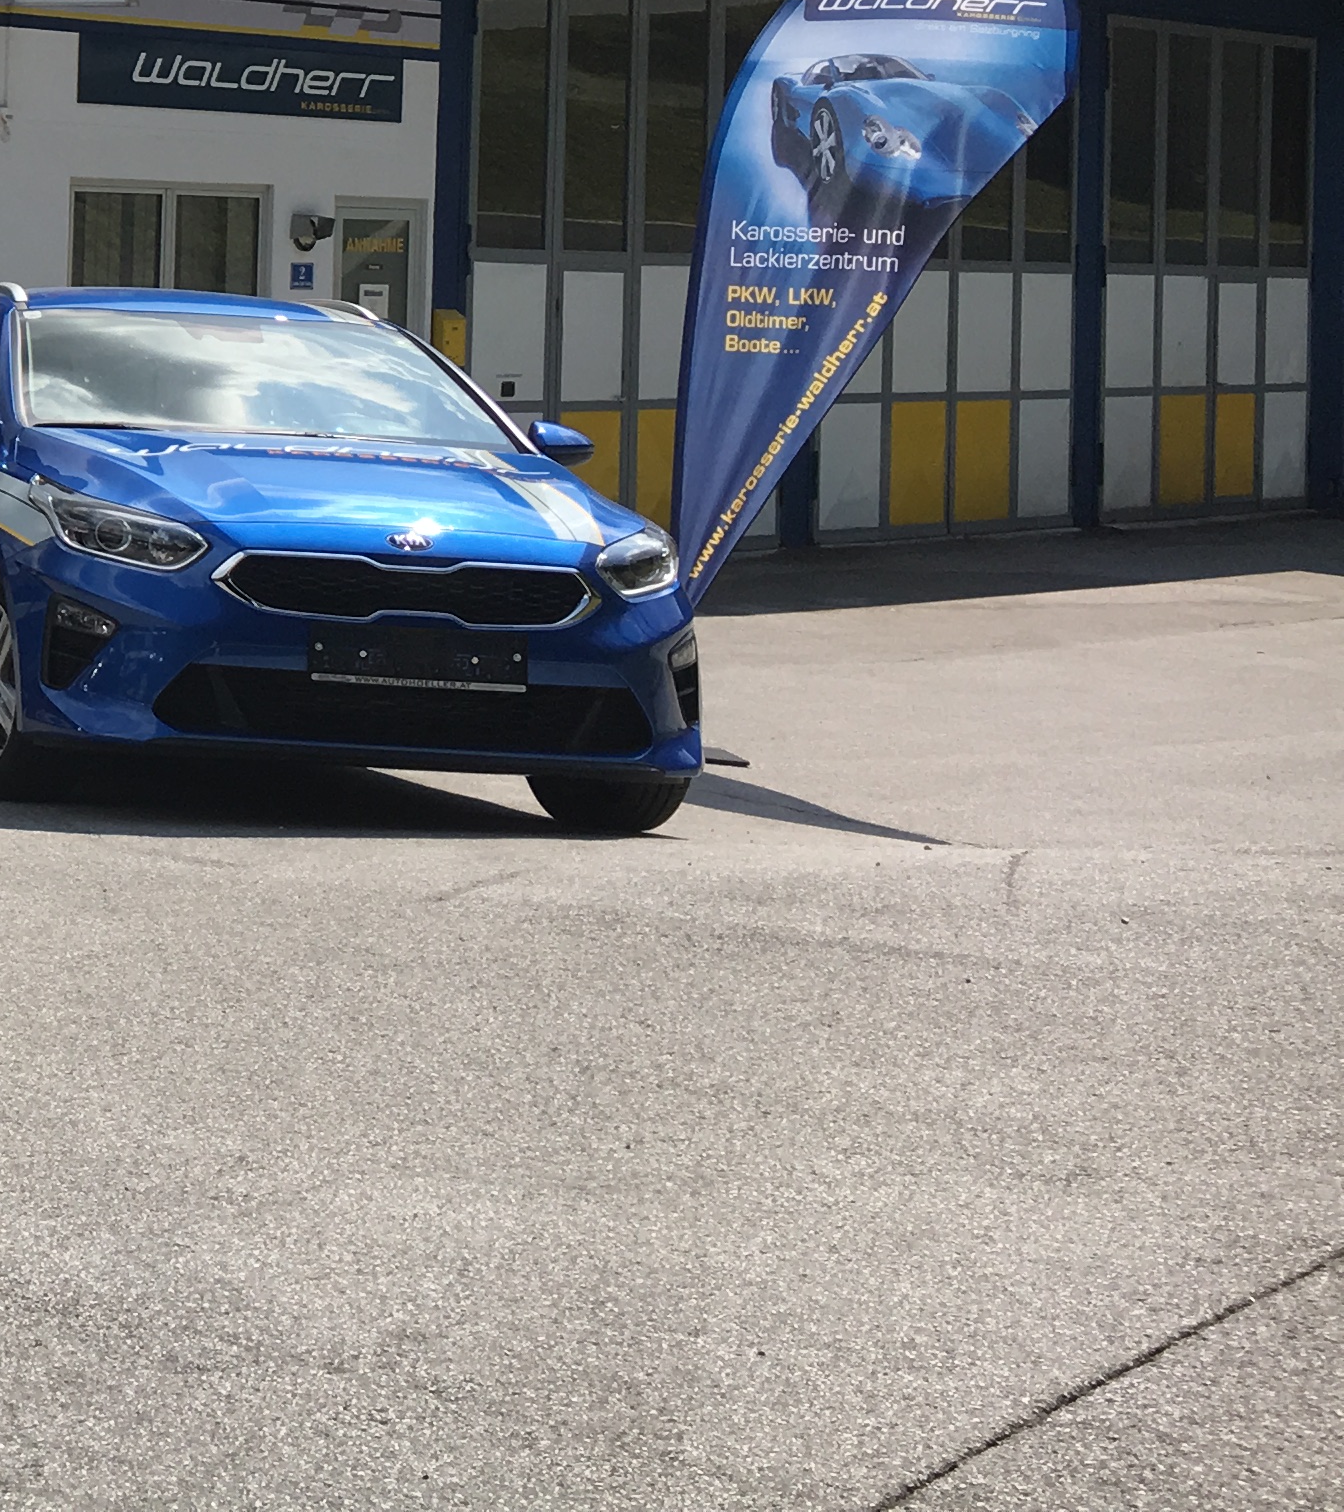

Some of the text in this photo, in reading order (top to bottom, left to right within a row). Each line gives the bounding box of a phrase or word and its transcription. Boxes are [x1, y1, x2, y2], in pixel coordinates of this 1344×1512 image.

[969, 24, 1040, 40] Salzburgring
[732, 220, 905, 245] Karosserie- und
[346, 237, 405, 253] ANNAHME
[730, 246, 899, 272] Lackierzentrum
[727, 285, 837, 308] PKW, LKW,
[726, 310, 810, 332] Oldtimer,
[689, 291, 888, 579] www.karosserie-waldherr.at
